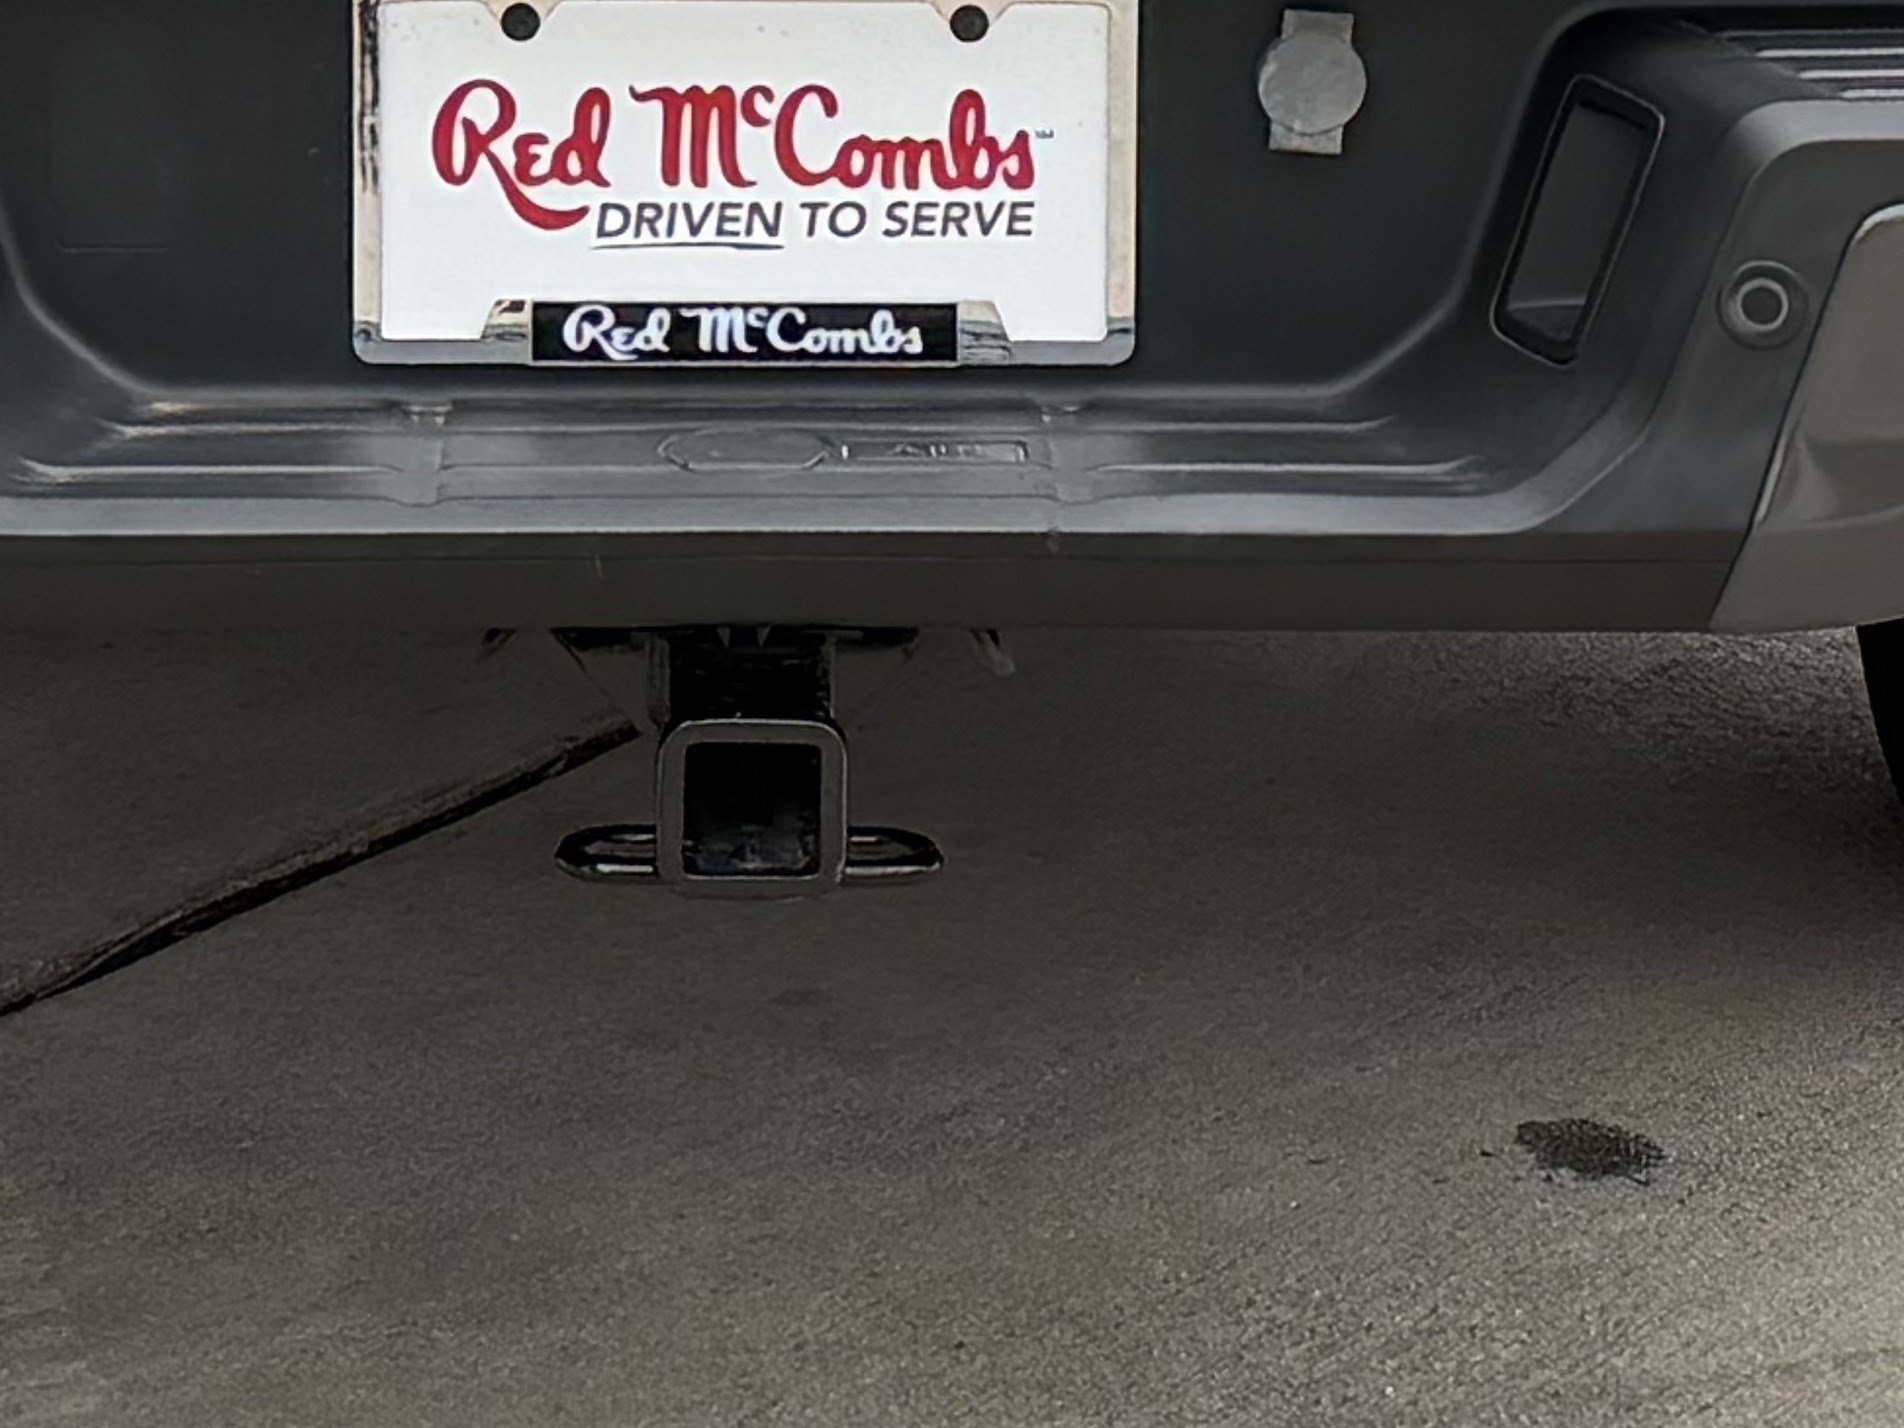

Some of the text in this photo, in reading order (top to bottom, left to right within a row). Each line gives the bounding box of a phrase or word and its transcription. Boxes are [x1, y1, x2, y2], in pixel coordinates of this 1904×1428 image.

[431, 78, 1036, 231] Red McCombs
[595, 200, 1036, 241] DRIVEN TO SERVE
[562, 303, 924, 362] Red McCombs
